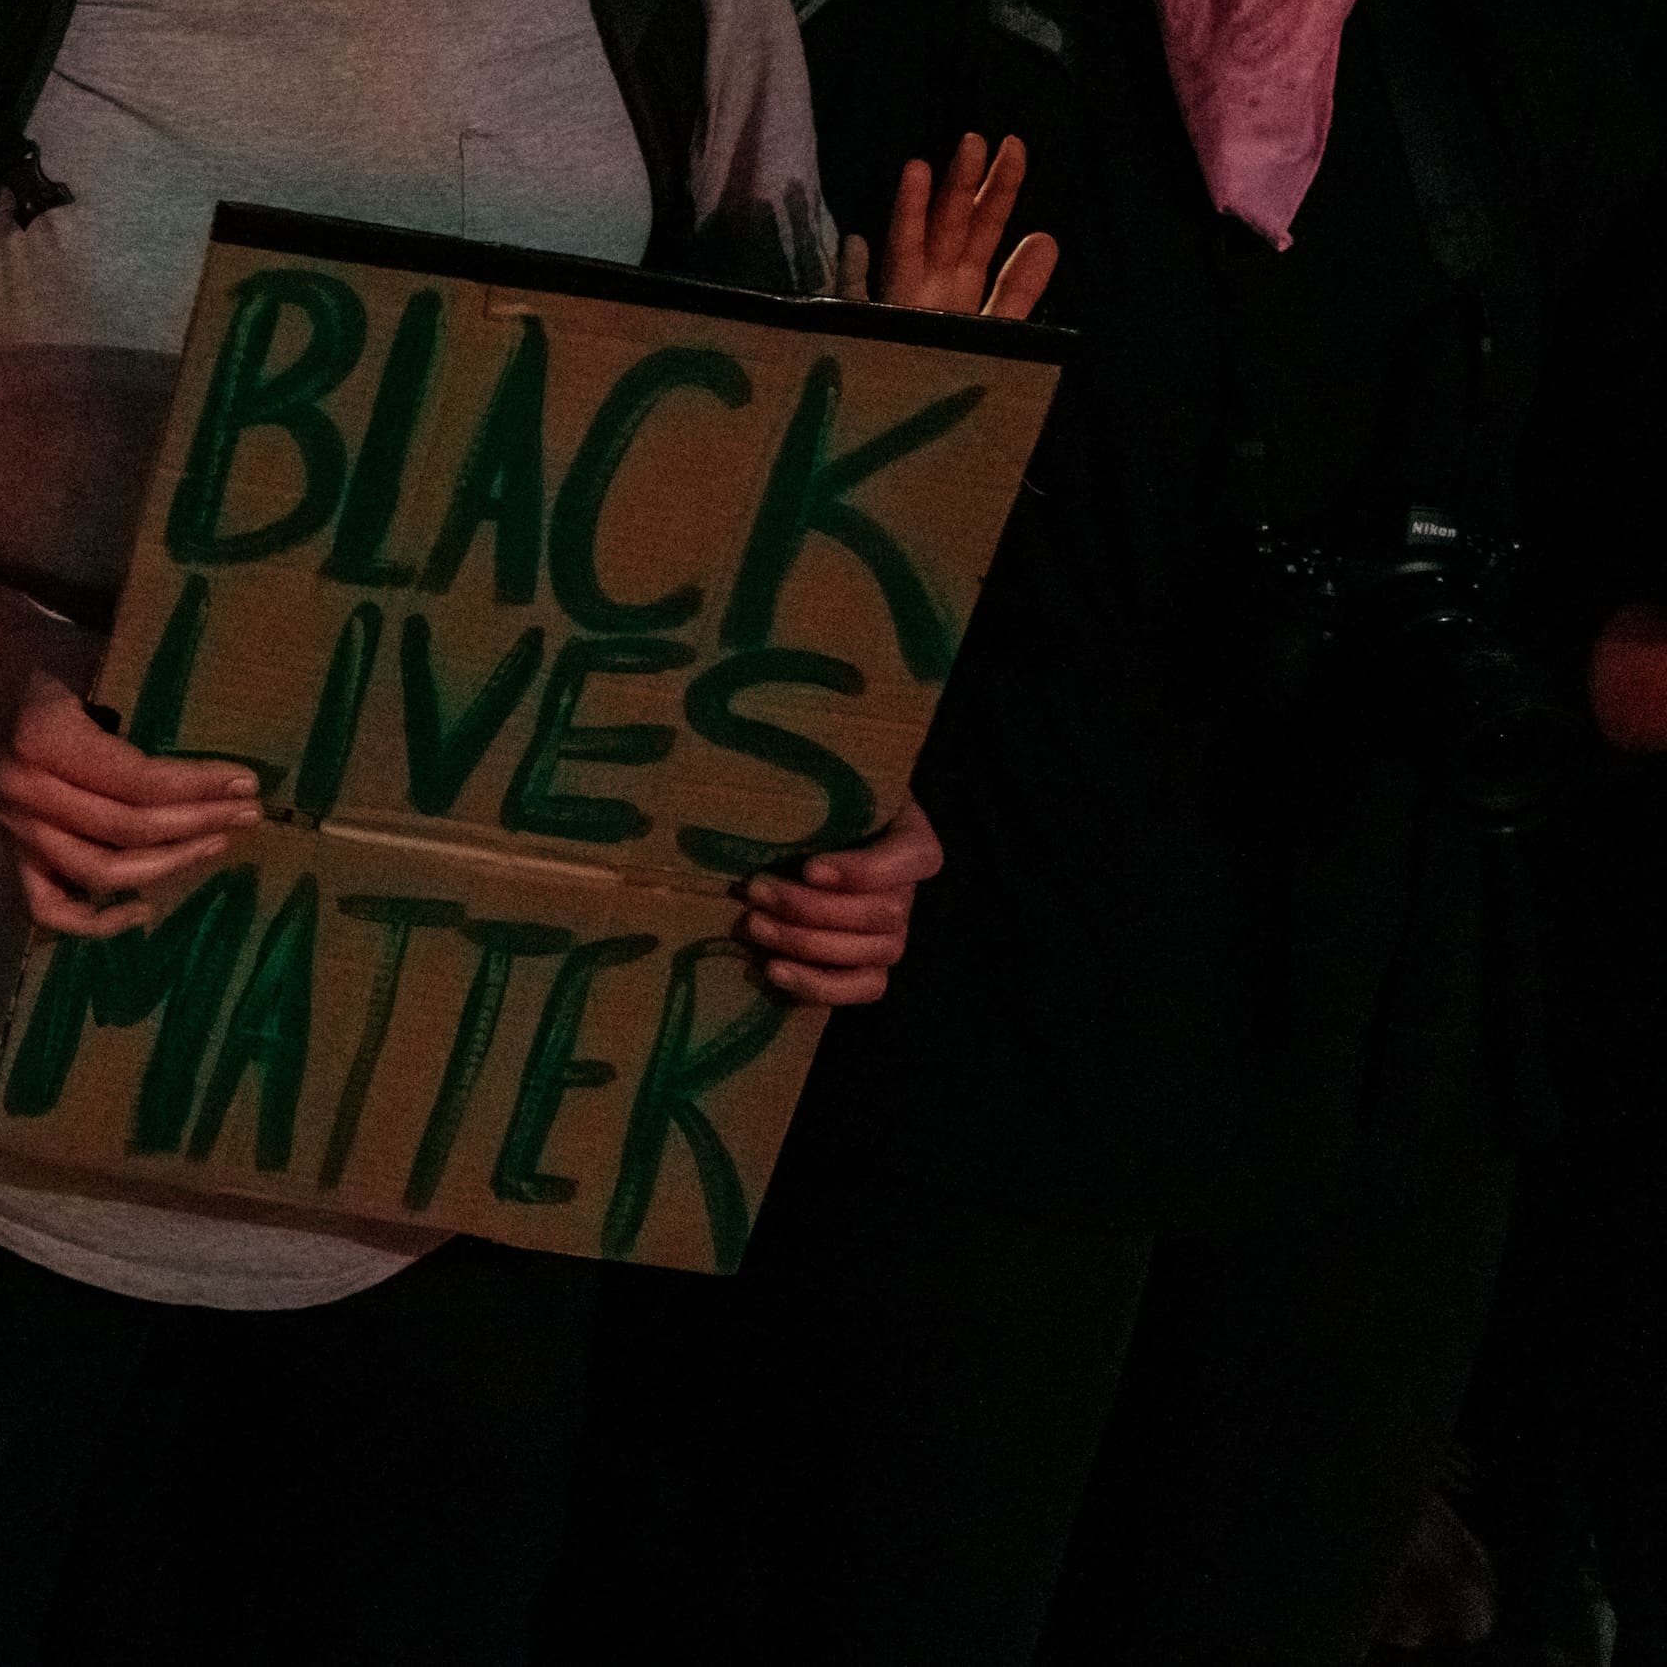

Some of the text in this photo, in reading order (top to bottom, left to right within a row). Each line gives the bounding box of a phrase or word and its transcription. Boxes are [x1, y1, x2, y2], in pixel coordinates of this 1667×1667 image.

[165, 268, 986, 682] BLACK
[1412, 521, 1458, 538] Nikon
[127, 574, 876, 876] LIVES
[4, 862, 791, 1276] MATTER
